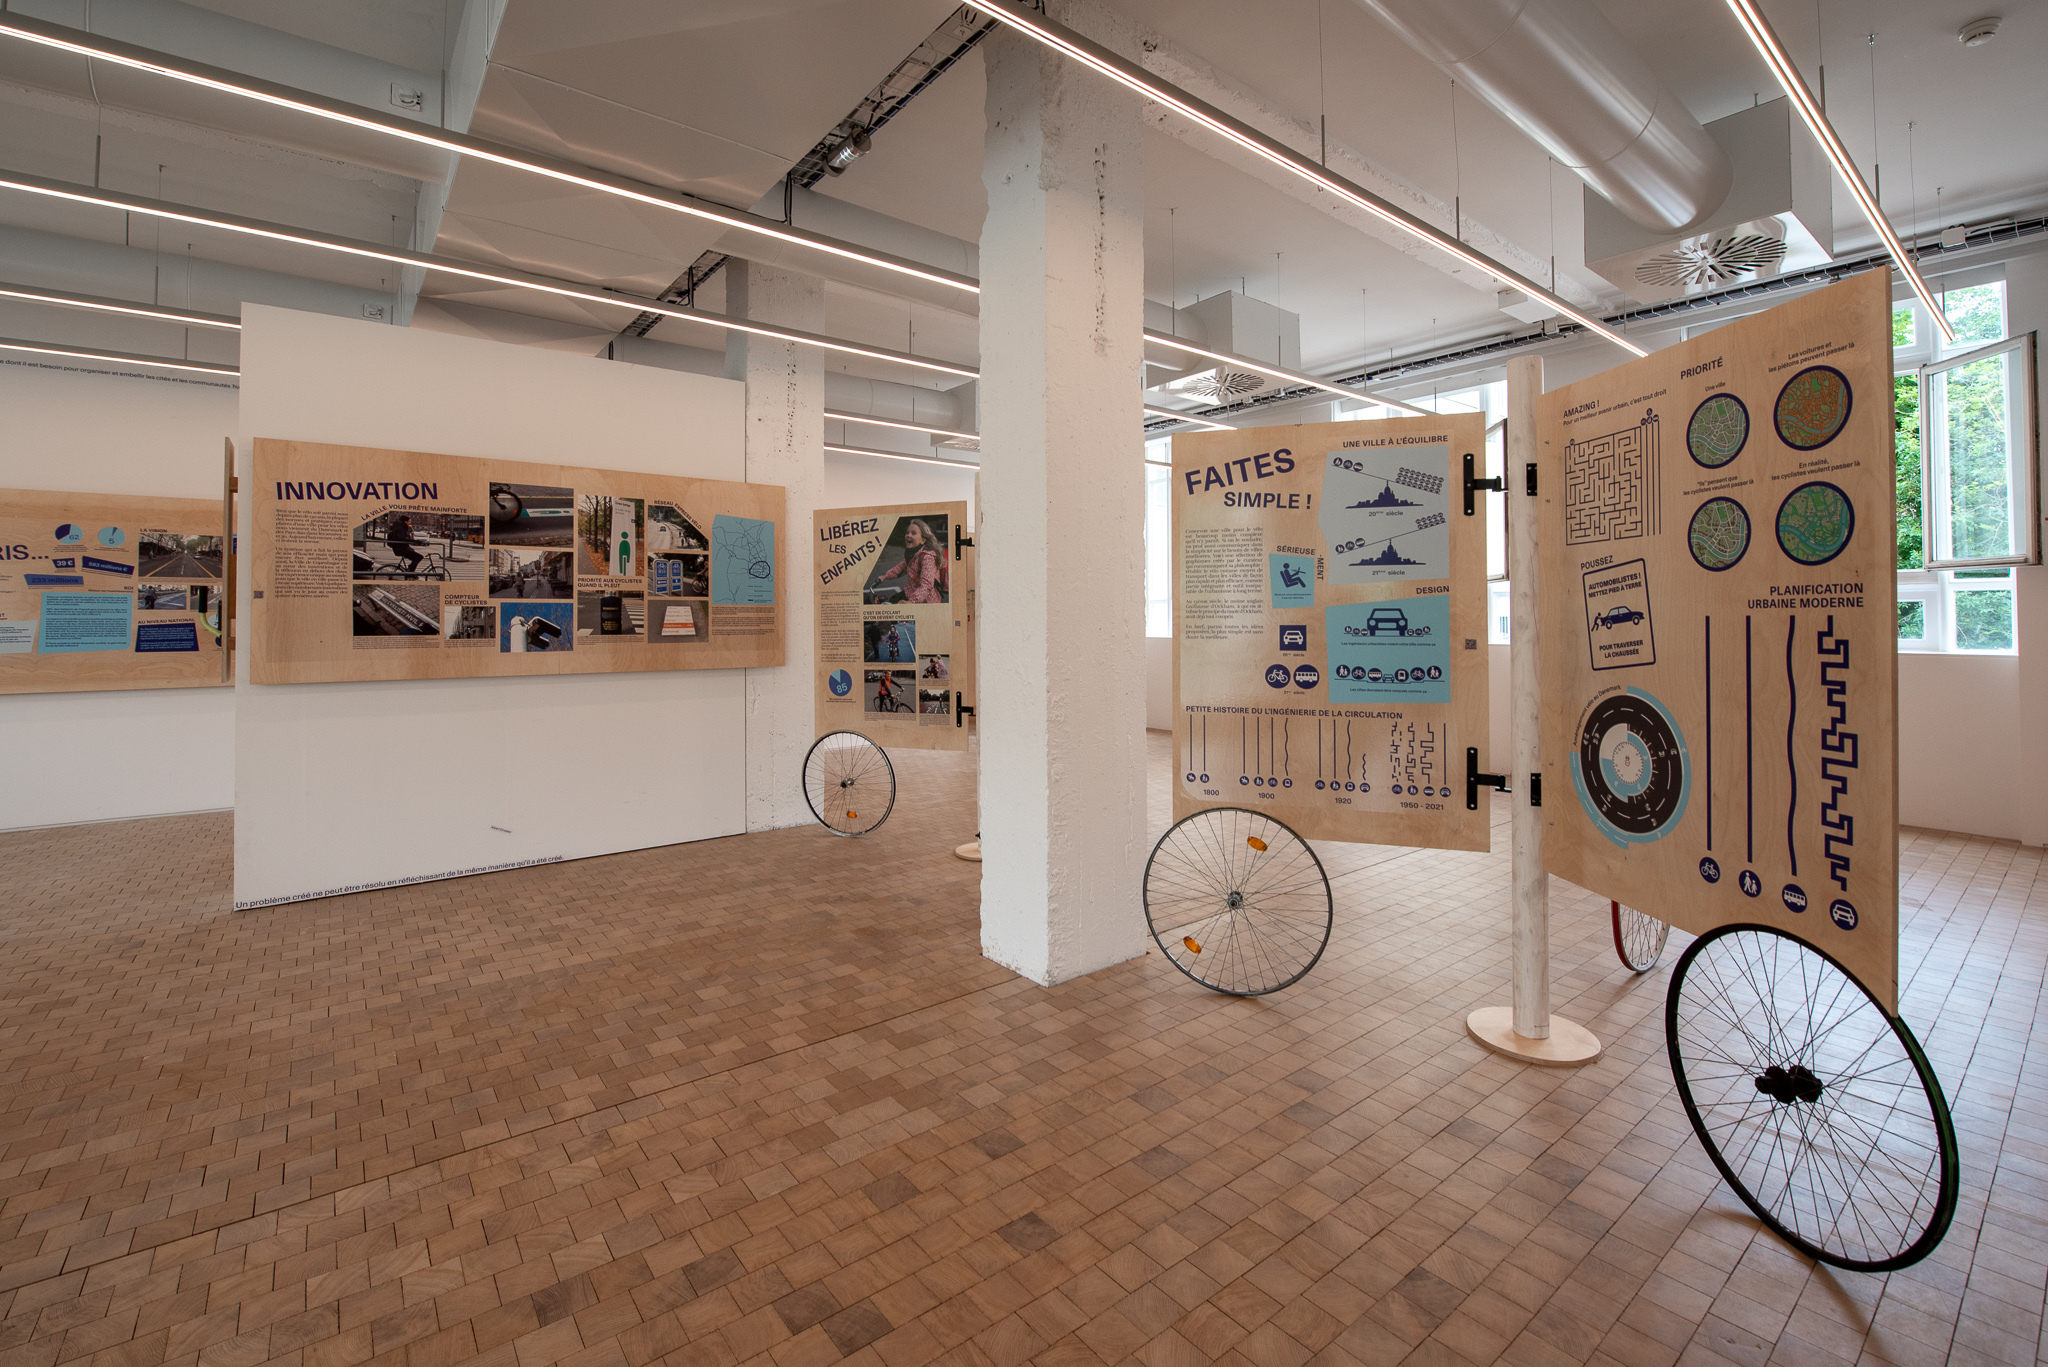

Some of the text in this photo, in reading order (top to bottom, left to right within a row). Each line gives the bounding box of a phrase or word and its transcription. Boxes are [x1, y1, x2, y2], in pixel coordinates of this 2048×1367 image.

[1800, 345, 1824, 355] voitures
[1778, 360, 1799, 371] piétons
[1800, 353, 1825, 365] peuvent
[1826, 346, 1848, 357] passer
[1680, 356, 1723, 380] PRIORITÉ
[80, 368, 111, 376] organiser
[189, 379, 231, 388] communautés
[1563, 400, 1600, 418] AMAZING !
[1579, 411, 1598, 421] meilleur
[1598, 407, 1612, 415] avenir
[1612, 403, 1630, 411] urbain,
[1630, 397, 1642, 405] c'est
[1653, 389, 1667, 397] droit
[1343, 434, 1448, 448] UNE VILLE À L'ÉQUILIBRE
[1808, 459, 1829, 467] réalité,
[1185, 448, 1295, 495] FAITES
[1780, 470, 1806, 480] cyclistes
[1807, 467, 1831, 475] veulent
[1831, 464, 1853, 472] passer
[1690, 487, 1711, 495] cyclistes
[1730, 481, 1748, 489] passer
[1707, 478, 1727, 486] pensent
[276, 482, 438, 500] INNOVATION
[1223, 491, 1312, 509] SIMPLE !
[361, 513, 371, 521] LA
[371, 505, 387, 517] VILLE
[430, 506, 467, 514] MAINFORTE
[674, 503, 692, 521] EXPRESS
[690, 518, 702, 530] VÉLO
[820, 517, 879, 542] LIBÉREZ
[109, 537, 115, 545] 5
[829, 543, 847, 554] LES
[1276, 545, 1316, 556] SÉRIEUSE
[100, 563, 123, 571] millions
[820, 535, 882, 585] ENFANTS !
[1580, 556, 1613, 571] POUSSEZ
[1588, 574, 1638, 591] AUTOMOBILISTES
[1416, 585, 1450, 595] DESIGN
[1588, 589, 1608, 598] METTEZ
[1625, 582, 1642, 590] TERRE
[1769, 583, 1863, 597] PLANIFICATION
[1747, 597, 1864, 609] URBAINE MODERNE
[1599, 640, 1644, 652] POUR TRAVERSER
[1612, 649, 1639, 658] CHAUSSÉE
[836, 683, 848, 694] 85
[1185, 705, 1403, 719] PETITE HISTOIRE DU L'INGÉNIERIE DE LA CIRCULATION
[1573, 708, 1587, 746] Aménagement
[1586, 699, 1594, 709] vélo
[1598, 685, 1621, 697] Danemark
[1203, 788, 1220, 796] 1800
[1257, 792, 1275, 800] 1900
[1335, 797, 1352, 805] 1920
[1399, 801, 1444, 811] 1950 2021
[235, 901, 248, 909] Un
[249, 896, 291, 909] problème
[292, 892, 311, 901] créé
[312, 890, 323, 898] ne
[324, 887, 343, 897] peut
[344, 884, 360, 893] être
[361, 881, 386, 890] résolu
[398, 871, 446, 884] réfléchissant
[446, 870, 456, 878] de
[464, 865, 487, 874] même
[488, 862, 516, 872] manière
[516, 859, 531, 869] qu'il
[536, 856, 547, 864] été
